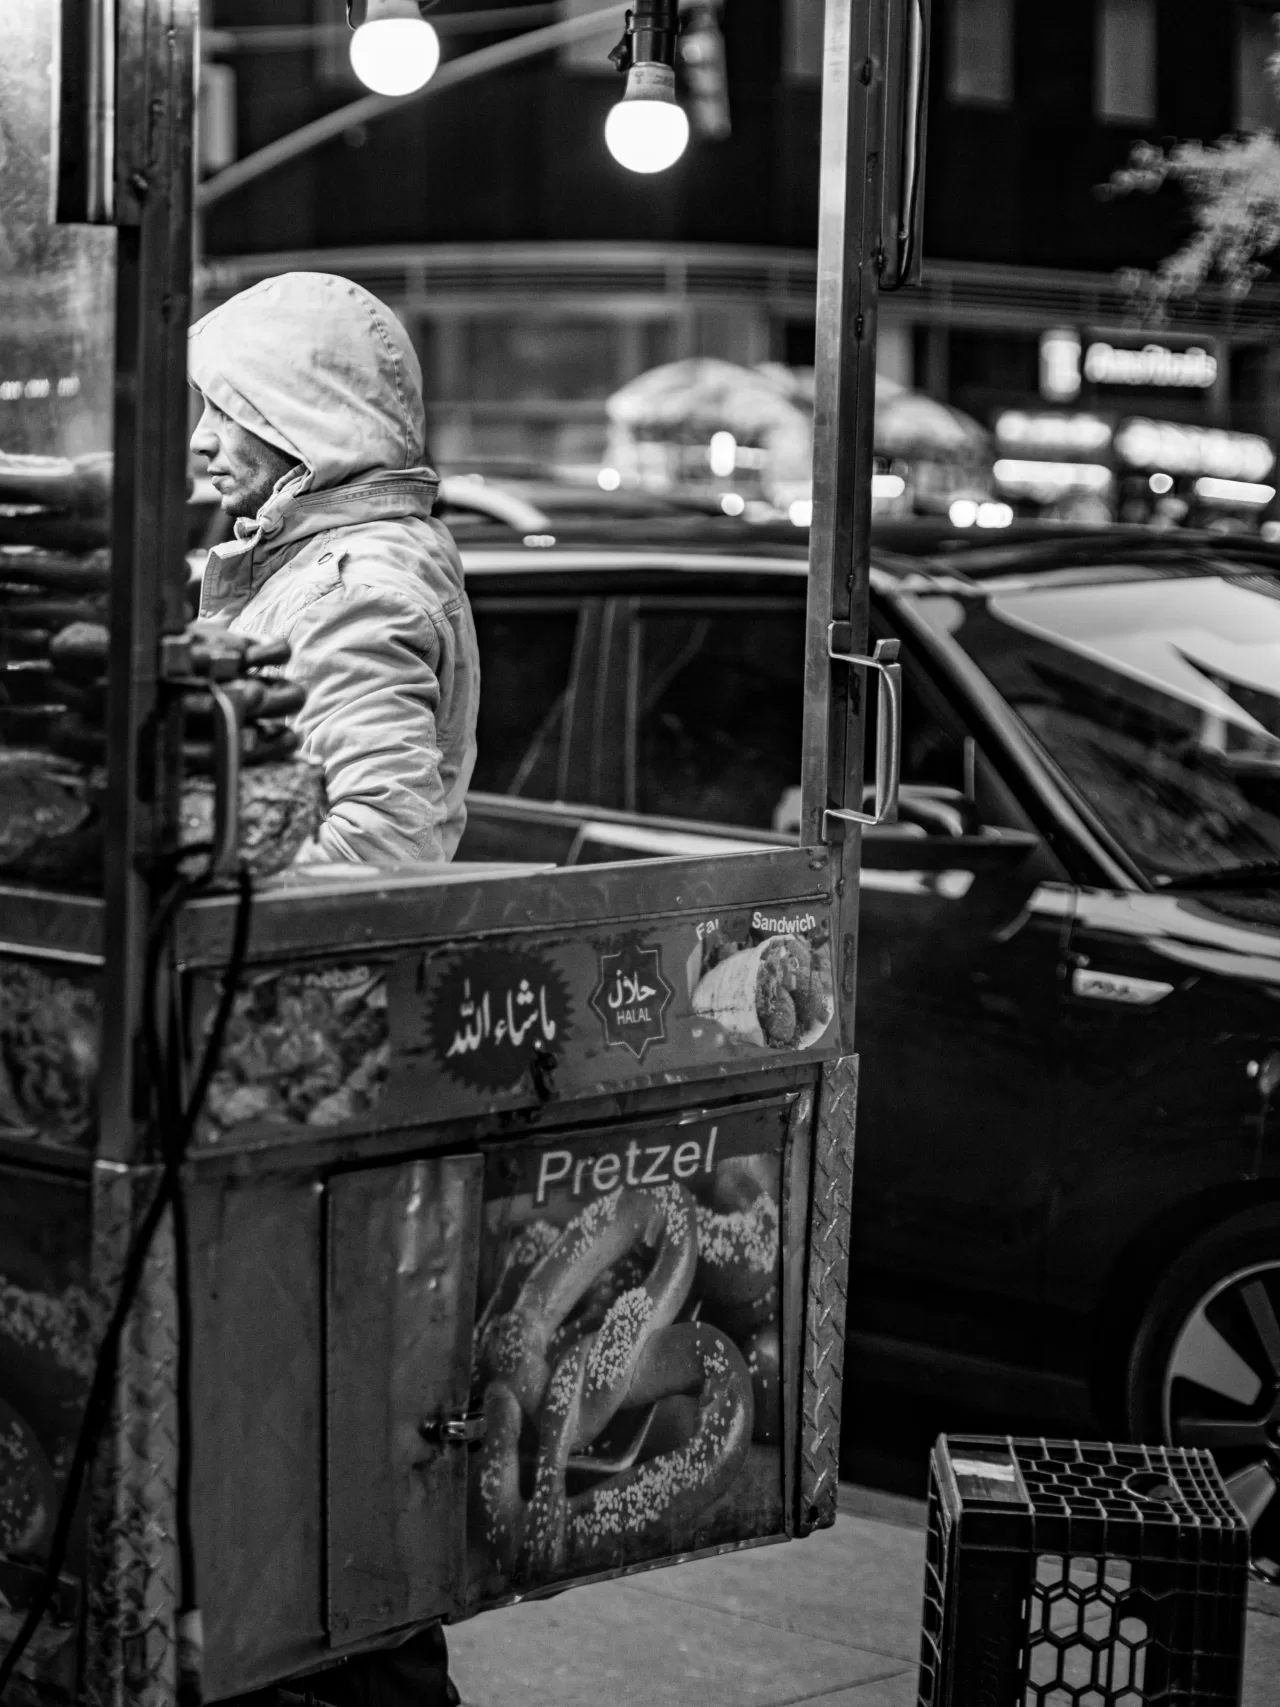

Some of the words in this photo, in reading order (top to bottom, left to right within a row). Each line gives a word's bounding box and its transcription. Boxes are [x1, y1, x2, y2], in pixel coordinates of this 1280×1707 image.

[752, 911, 817, 934] Sandwich
[608, 969, 658, 1010] حلال
[616, 1008, 652, 1026] HALAL
[535, 1125, 719, 1203] Pretzel
